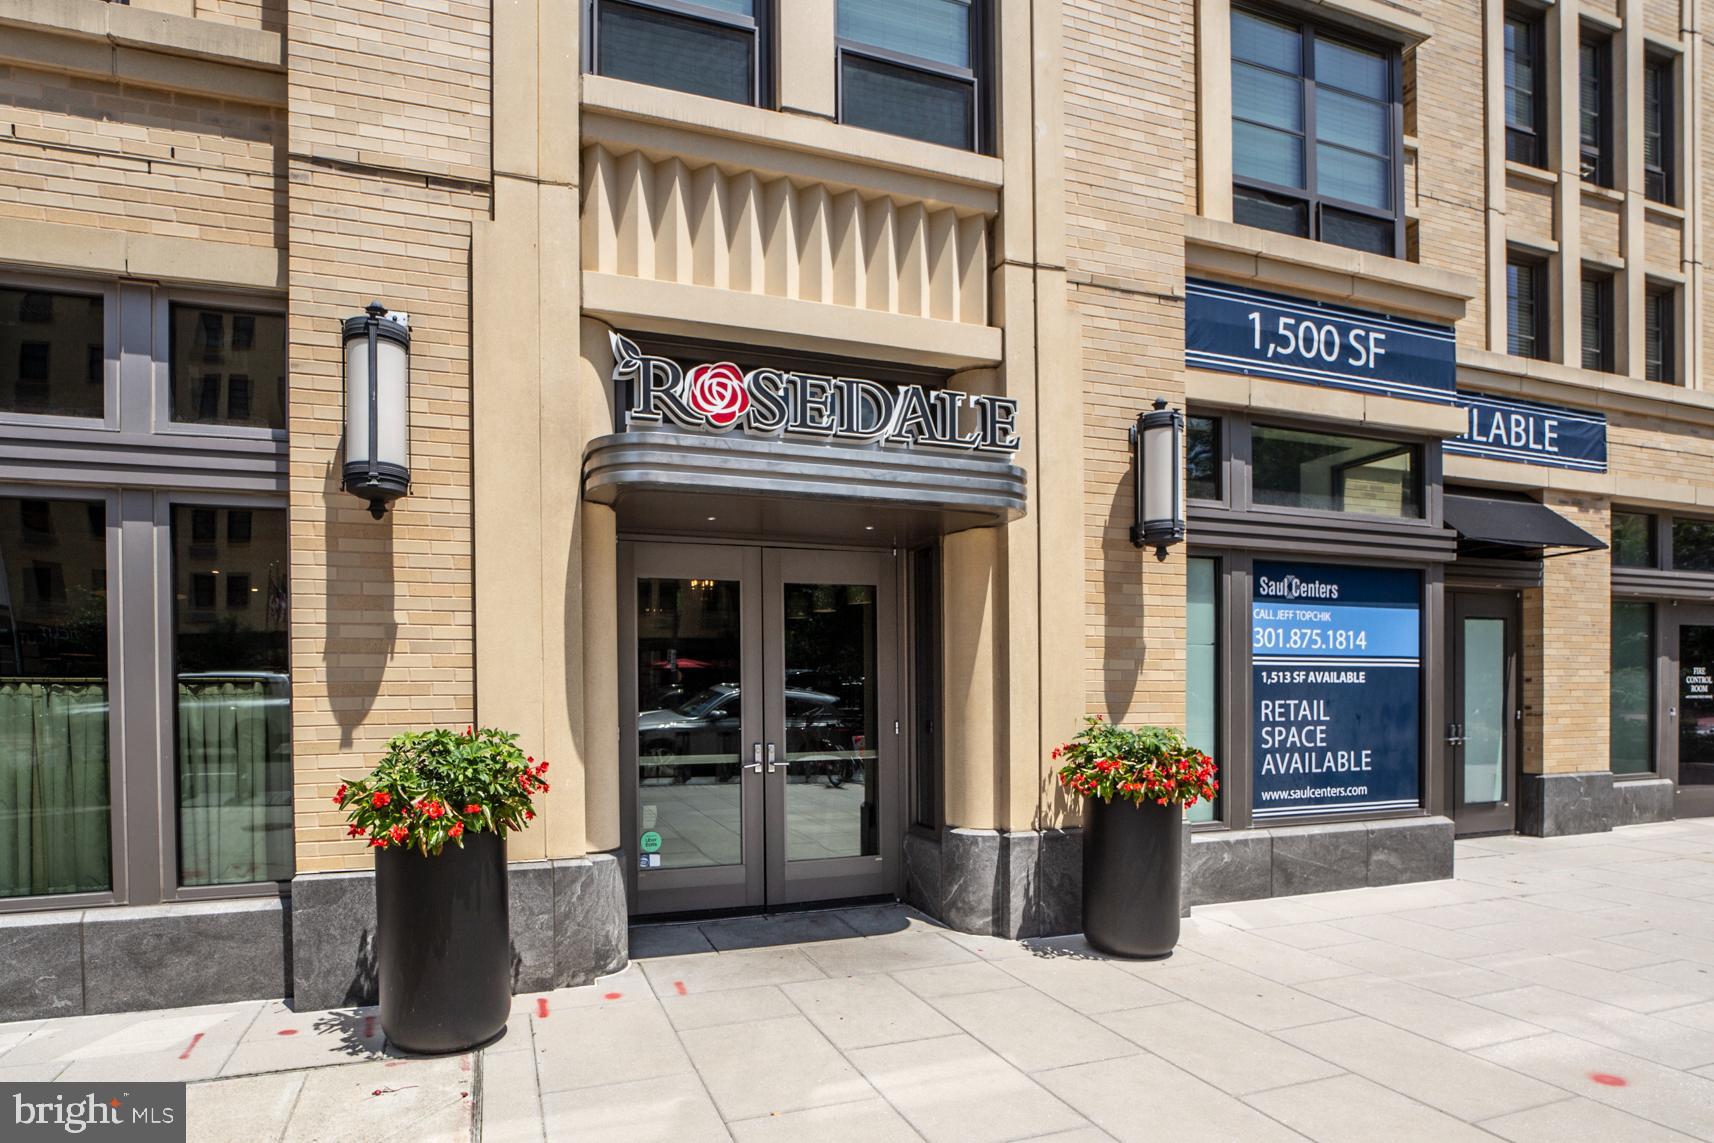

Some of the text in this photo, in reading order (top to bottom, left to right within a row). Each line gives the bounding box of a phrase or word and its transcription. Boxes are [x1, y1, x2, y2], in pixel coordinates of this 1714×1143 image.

[1248, 311, 1387, 369] 1,500 SF
[625, 353, 1022, 453] ROSEDALE
[1456, 407, 1558, 452] LABLE
[1260, 576, 1339, 599] Saul Centers
[1253, 608, 1332, 622] CALL JEFF TOPCHIK
[1253, 627, 1367, 650] 301.875.1814
[1261, 671, 1366, 685] 1,513 SF AVAILABLE
[1261, 700, 1330, 722] RETAIL
[1261, 725, 1327, 749] SPACE
[1261, 750, 1372, 776] AVAILABLE
[1261, 785, 1368, 801] www.saulcenters.com
